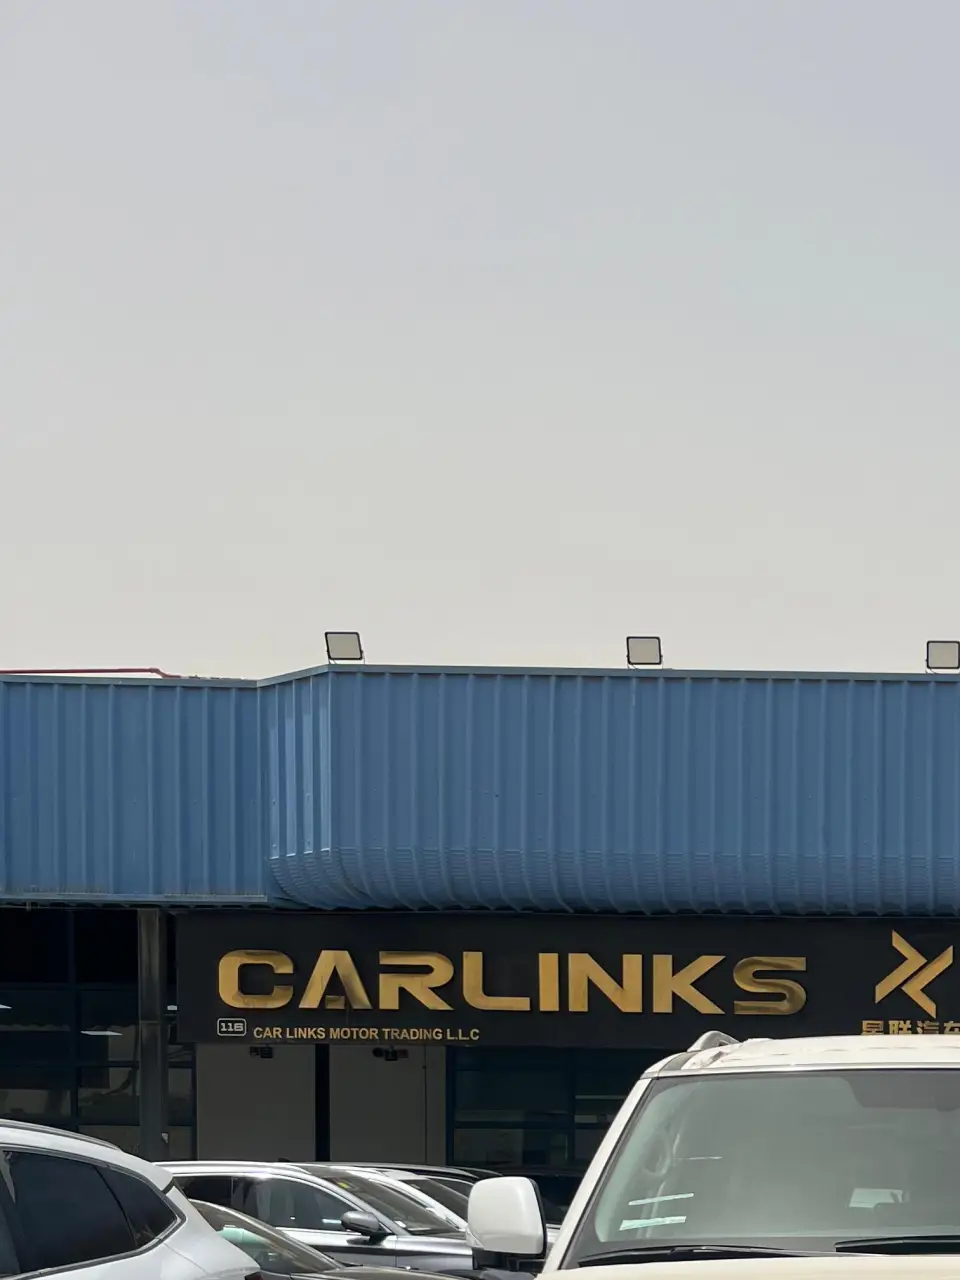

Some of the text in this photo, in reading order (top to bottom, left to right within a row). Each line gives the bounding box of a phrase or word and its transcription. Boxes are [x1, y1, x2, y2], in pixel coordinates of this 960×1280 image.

[218, 949, 807, 1015] CARLINKS
[219, 1021, 245, 1033] 116
[253, 1026, 283, 1039] CAR
[286, 1026, 326, 1039] LINKS
[329, 1027, 379, 1040] MOTOR
[382, 1027, 443, 1040] TRADING
